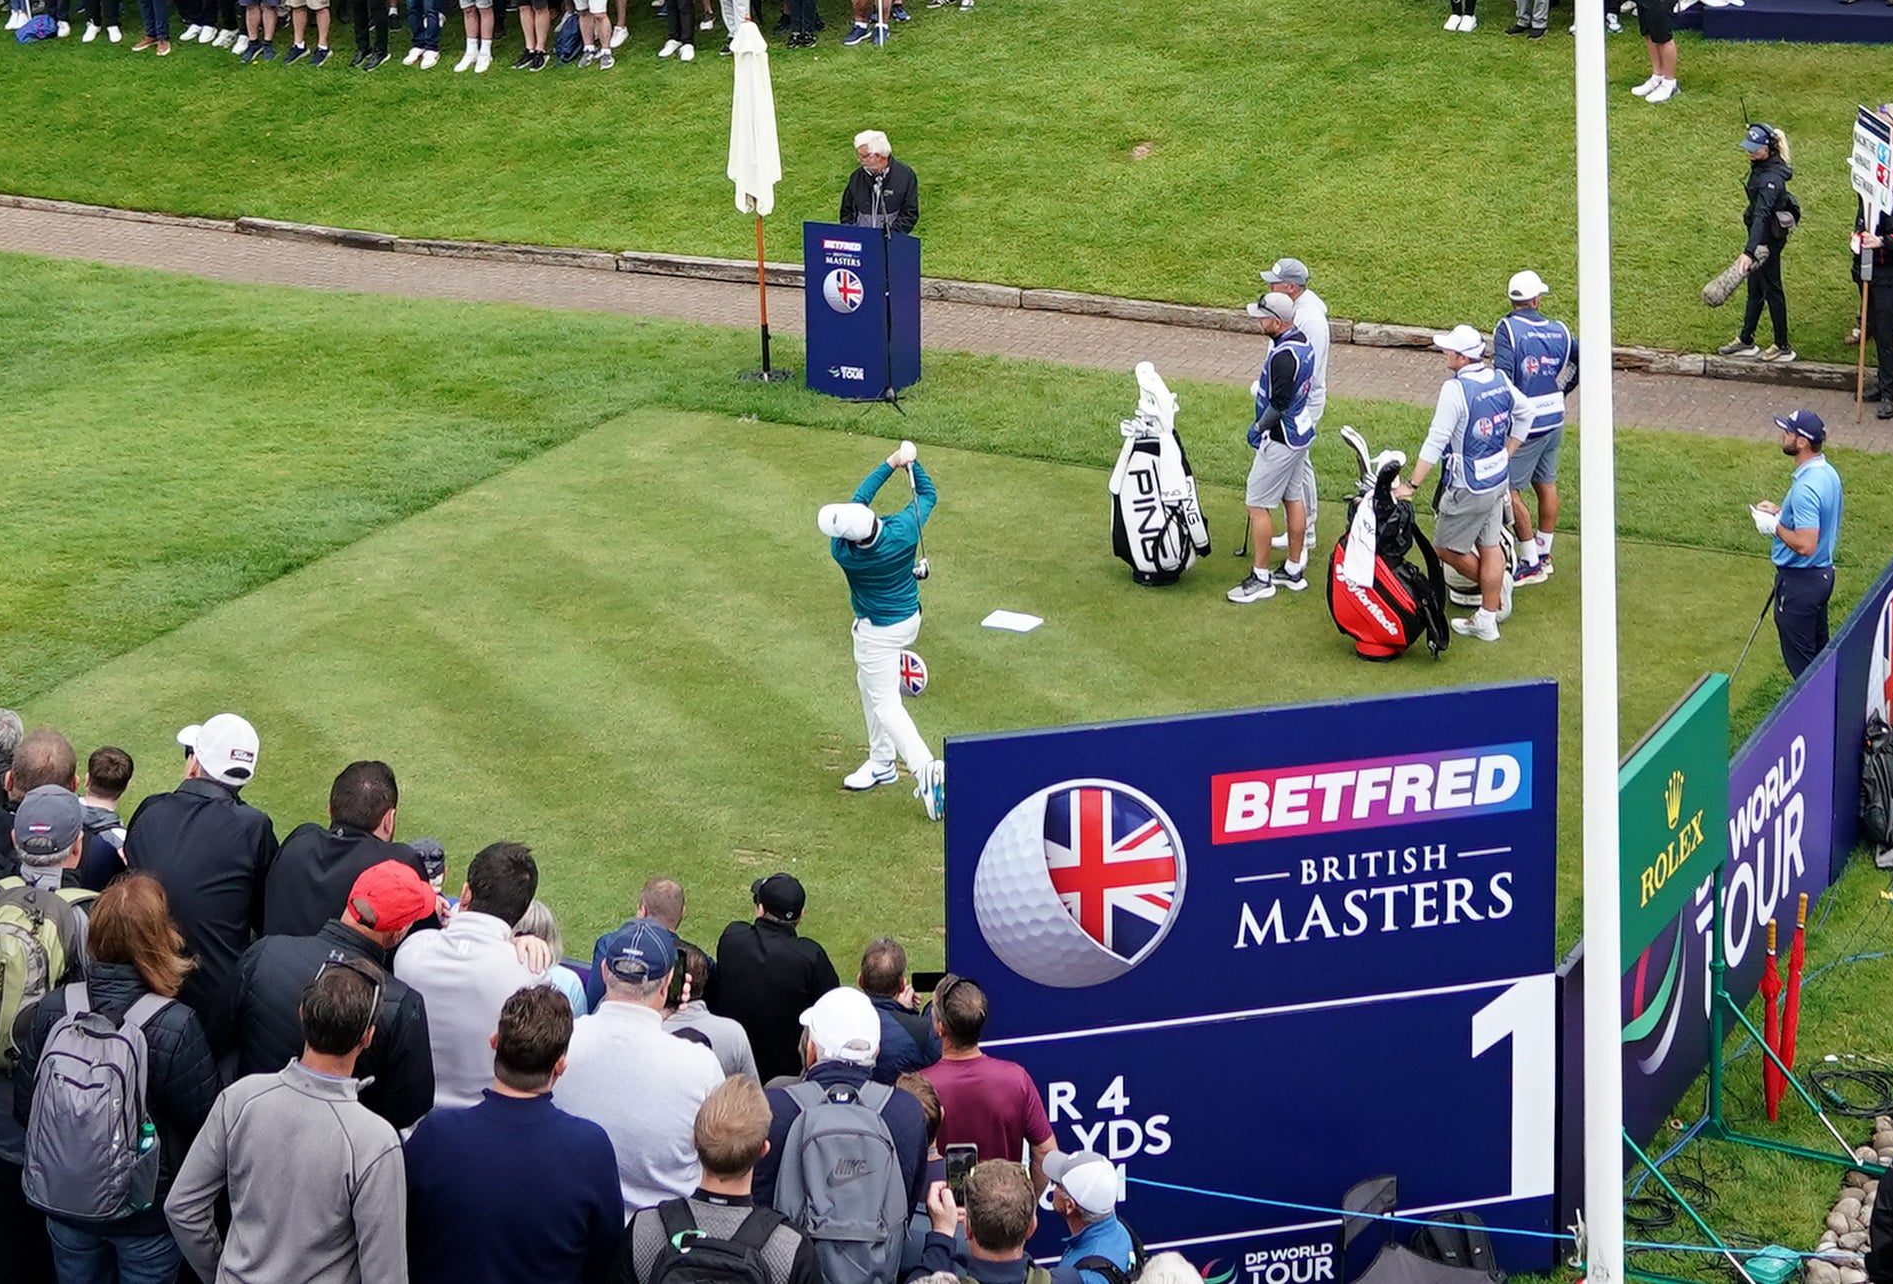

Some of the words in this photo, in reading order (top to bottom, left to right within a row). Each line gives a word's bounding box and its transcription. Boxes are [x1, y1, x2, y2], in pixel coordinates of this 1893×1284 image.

[825, 257, 861, 267] MASTERS
[840, 370, 864, 381] TOUR
[1128, 470, 1168, 562] PING
[1224, 754, 1521, 833] BETFRED
[1729, 734, 1806, 861] WORLD
[1300, 844, 1448, 886] BRITISH
[1640, 809, 1705, 908] ROLEX
[1234, 871, 1514, 949] MASTERS
[1695, 792, 1806, 1020] TOUR
[1048, 1081, 1083, 1123] R
[1097, 1075, 1130, 1116] 4
[1472, 973, 1555, 1196] 1
[1071, 1114, 1172, 1160] YDS
[835, 1158, 867, 1175] NIKE
[1245, 1251, 1268, 1266] DP
[1270, 1243, 1333, 1262] WORLD
[1245, 1256, 1335, 1284] TOUR
